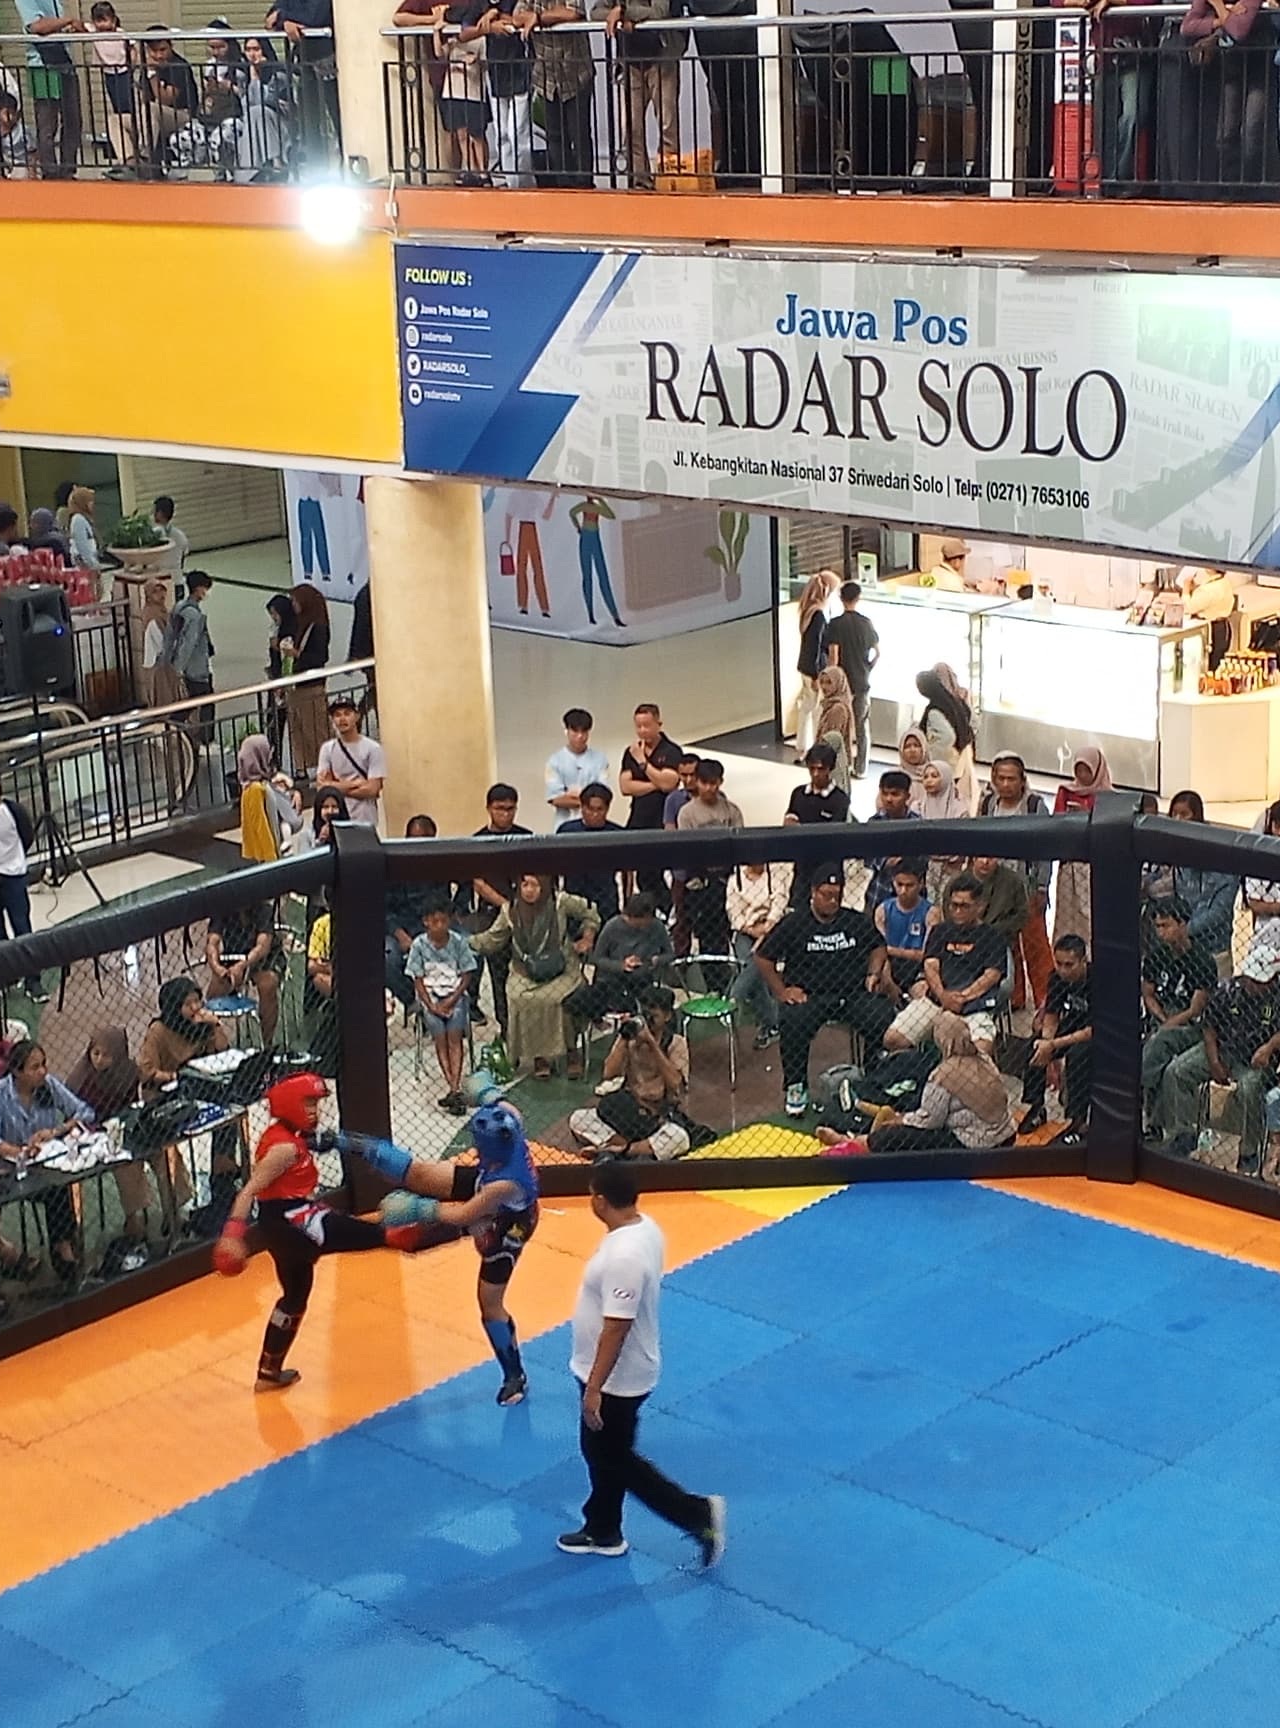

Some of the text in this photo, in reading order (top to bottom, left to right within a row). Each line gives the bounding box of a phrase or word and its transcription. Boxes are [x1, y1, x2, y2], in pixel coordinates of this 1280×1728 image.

[405, 268, 450, 285] FOLLOW
[451, 270, 466, 286] US
[777, 293, 969, 347] Jawa Pos
[640, 339, 1128, 462] RADAR SOLO
[1129, 370, 1181, 402] RADAR
[673, 450, 688, 467] Jl.
[690, 452, 768, 477] Kebangkitan
[771, 459, 825, 482] Nasional
[828, 466, 844, 484] 37
[847, 468, 910, 491] Sriwedari
[913, 474, 944, 494] Solo
[954, 478, 983, 501] Telp:
[986, 480, 1028, 506] (0271)
[1030, 486, 1091, 509] 7653106
